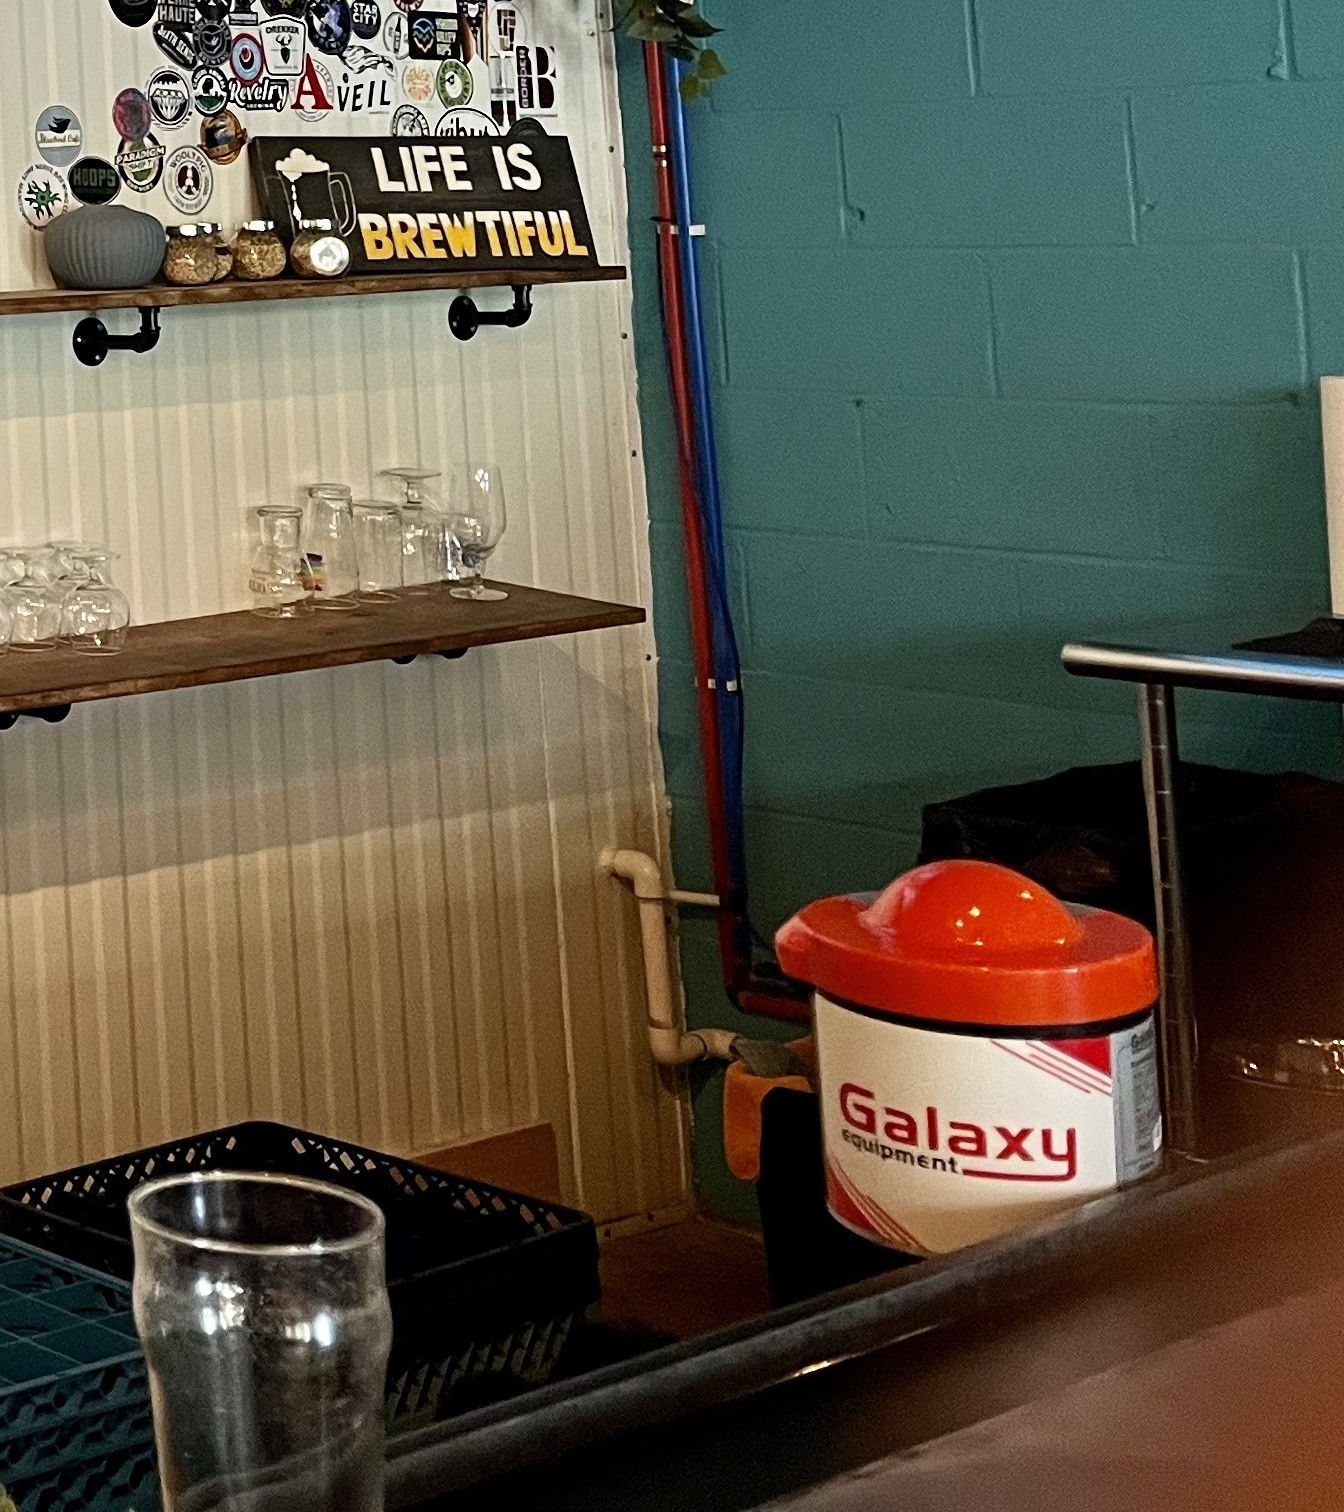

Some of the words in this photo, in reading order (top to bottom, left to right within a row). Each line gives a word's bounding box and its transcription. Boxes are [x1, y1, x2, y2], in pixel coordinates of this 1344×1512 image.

[159, 5, 195, 24] HAUTE
[353, 4, 377, 14] STAR
[353, 13, 378, 24] CITY
[229, 79, 288, 111] Revelry
[337, 80, 390, 111] VEIL
[116, 147, 165, 163] PARADIGM
[370, 145, 473, 192] LIFE
[493, 143, 541, 191] IS
[73, 168, 115, 186] HOOPS
[357, 210, 588, 261] BREWTIFUL
[839, 1082, 1076, 1181] Galaxy
[842, 1128, 959, 1174] equipment
